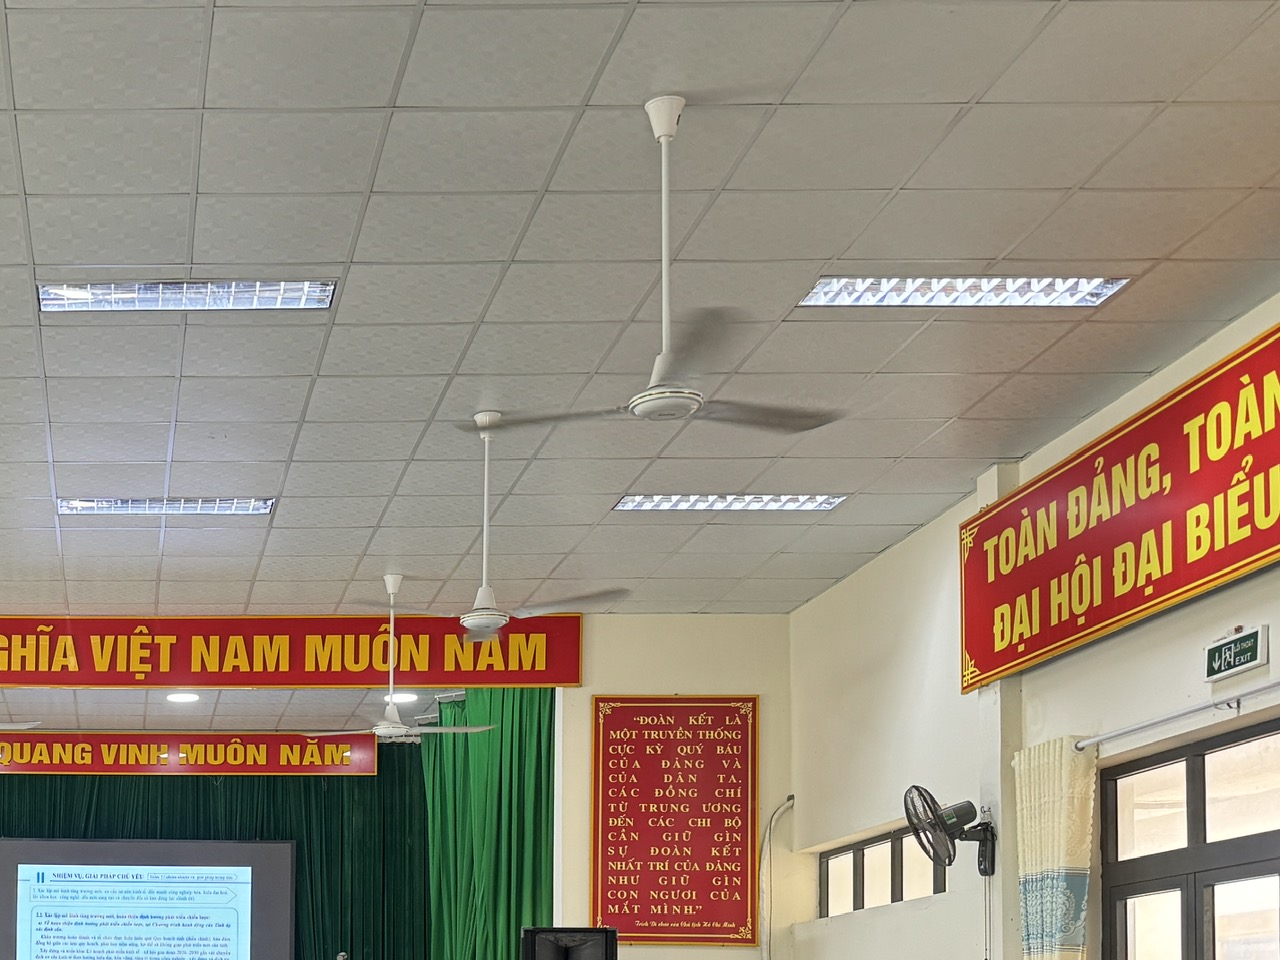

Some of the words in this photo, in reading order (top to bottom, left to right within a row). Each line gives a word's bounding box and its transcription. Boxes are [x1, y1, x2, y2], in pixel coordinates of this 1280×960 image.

[982, 500, 1057, 583] TOÀN
[1066, 442, 1171, 540] ĐẢNG,
[993, 588, 1040, 654] ĐẠI
[1051, 553, 1101, 625] HỘI
[1113, 520, 1173, 596] ĐẠI
[1186, 454, 1280, 564] BIỂU
[90, 626, 177, 680] VIỆT
[191, 634, 288, 673] NAM
[304, 623, 430, 673] MUÔN
[1235, 653, 1251, 665] EXIT
[634, 714, 674, 724] “ĐOÀN
[689, 712, 714, 724] KẾT
[726, 714, 741, 724] LÀ
[610, 728, 638, 741] MỘT
[642, 727, 692, 739] TRUYỀN
[697, 727, 741, 739] THỐNG
[101, 745, 169, 765] VINH
[180, 738, 267, 766] MUÔN
[279, 737, 351, 766] NĂM
[609, 744, 634, 756] CỰC
[646, 743, 663, 754] KỲ
[677, 744, 703, 755] QUÝ
[717, 744, 741, 754] BÁU
[609, 757, 640, 768] CỦA
[662, 758, 704, 768] ĐẢNG
[722, 758, 741, 768] VÀ
[609, 772, 637, 782] CỦA
[664, 772, 696, 782] DÂN
[717, 775, 741, 783] TA.
[609, 786, 639, 797] CÁC
[655, 785, 697, 797] ĐỒNG
[715, 787, 741, 797] CHÍ
[608, 801, 628, 812] TỪ
[639, 804, 689, 812] TRUNG
[703, 803, 740, 812] ƯƠNG
[609, 814, 633, 826] ĐẾN
[649, 816, 674, 826] CÁC
[689, 818, 710, 827] CHI
[725, 816, 741, 829] BỘ
[608, 829, 638, 840] CẦN
[663, 831, 691, 841] GIỮ
[714, 831, 741, 841] GÌN
[608, 845, 627, 858] SỰ
[651, 845, 691, 855] ĐOÀN
[712, 844, 741, 856] KẾT
[609, 858, 643, 870] NHẤT
[648, 860, 669, 870] TRÍ
[675, 860, 700, 871] CỦA
[706, 860, 740, 871] ĐẢNG
[609, 875, 639, 884] NHƯ
[659, 875, 689, 885] GIỮ
[713, 875, 741, 885] GÌN
[608, 890, 638, 899] CON
[710, 889, 740, 900] CỦA
[608, 901, 640, 913] MẮT
[651, 903, 702, 914] MÌNH.”
